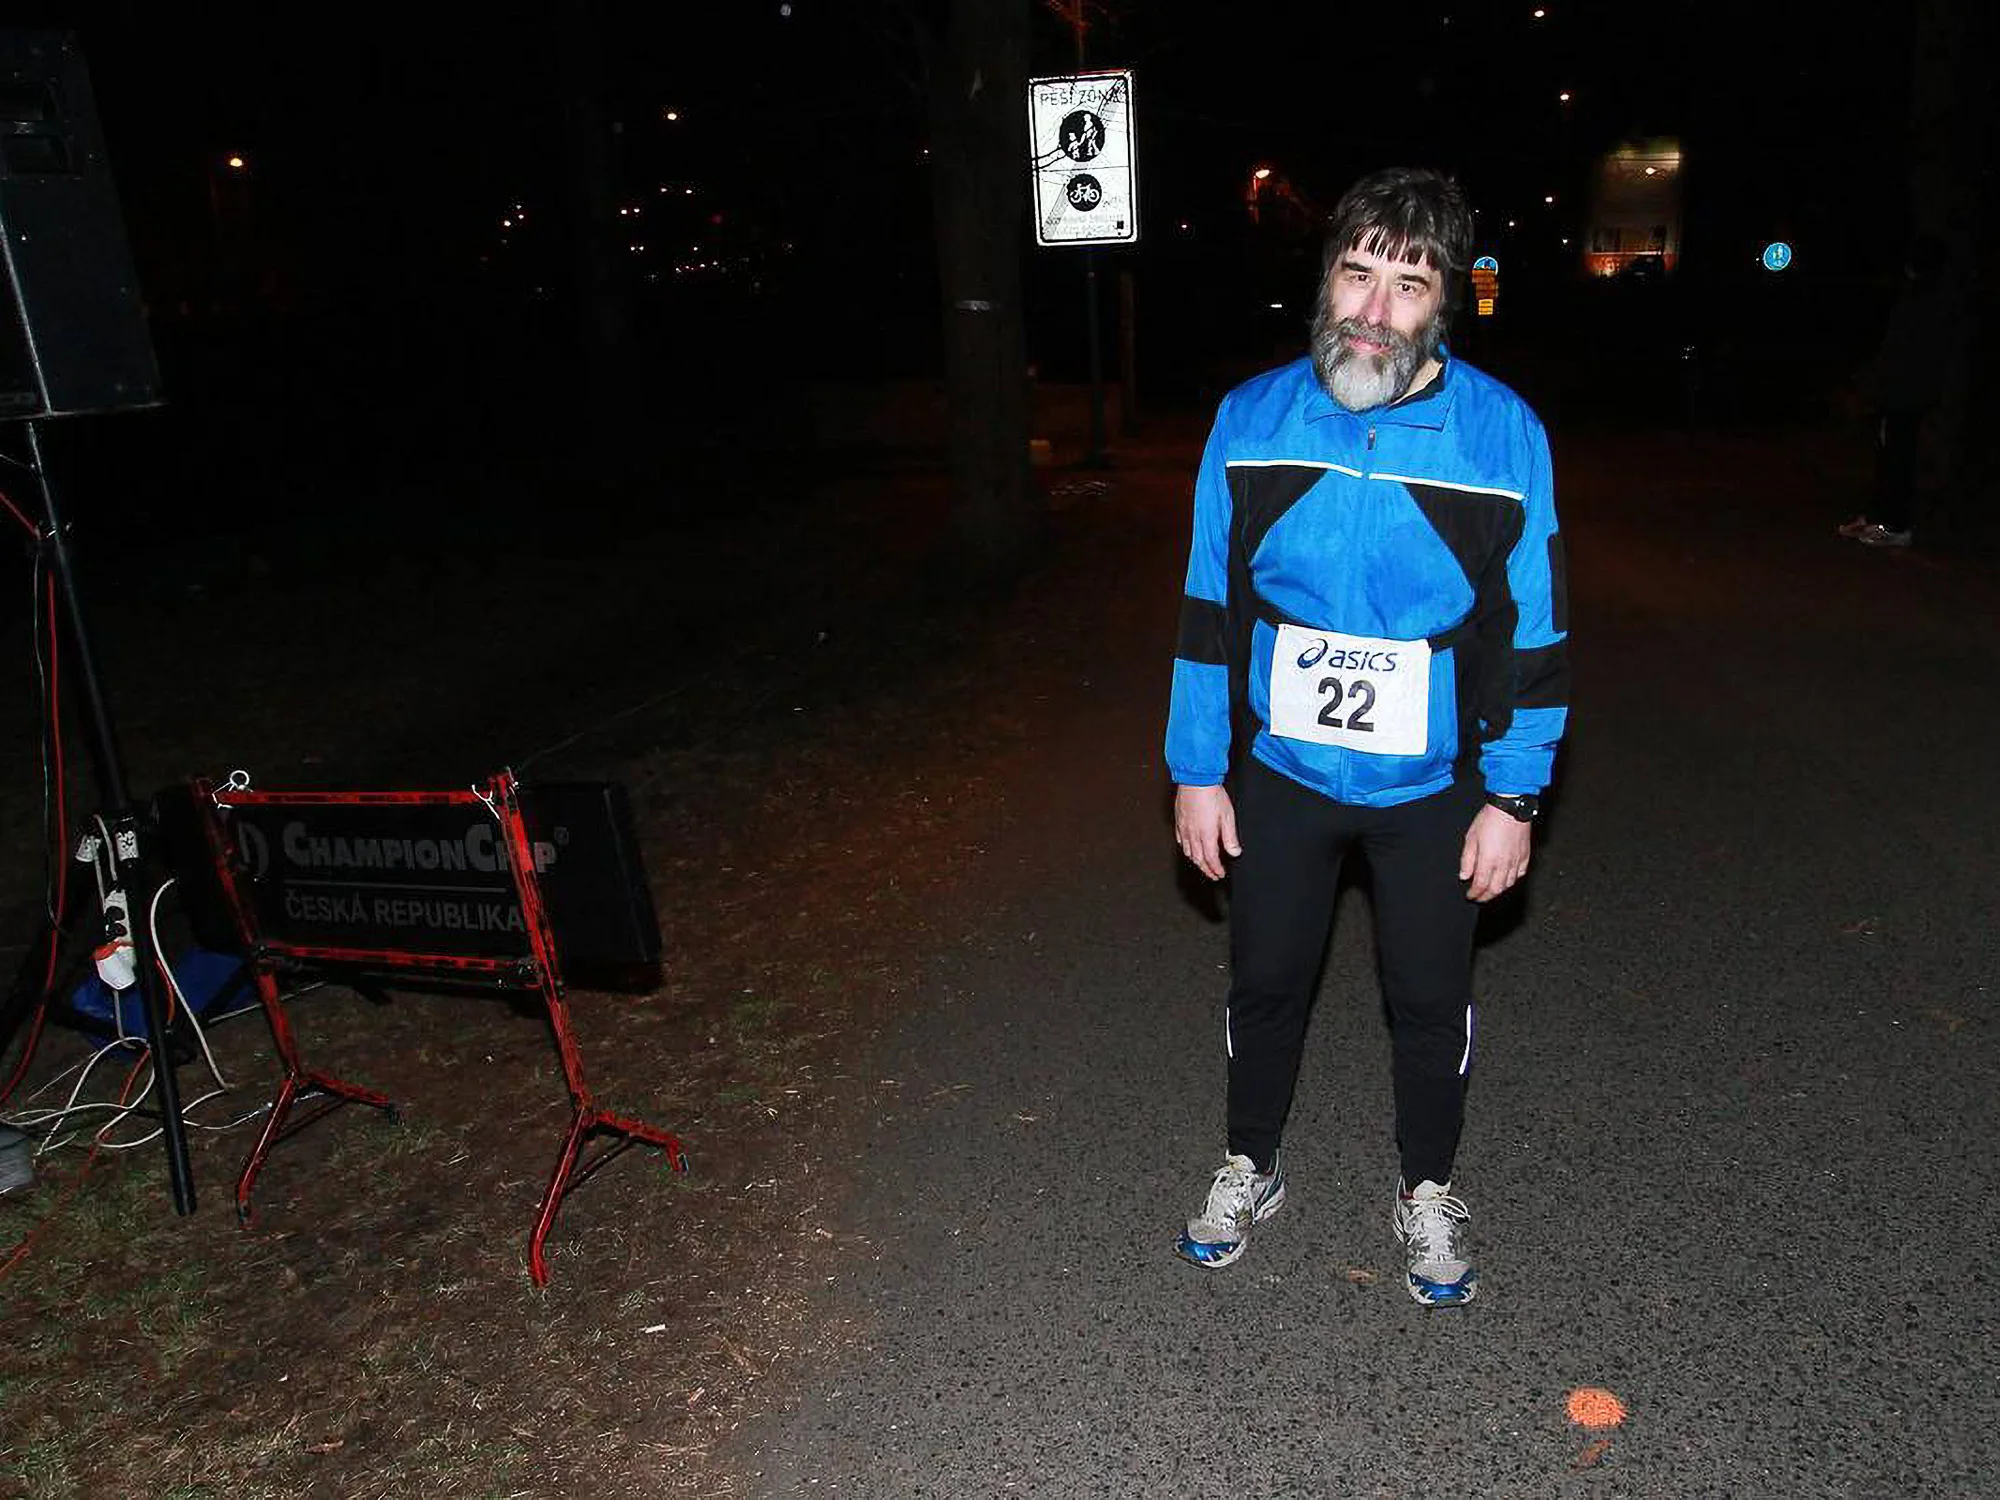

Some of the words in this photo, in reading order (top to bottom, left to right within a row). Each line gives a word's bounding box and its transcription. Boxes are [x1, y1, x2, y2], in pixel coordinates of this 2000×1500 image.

[1328, 648, 1398, 672] asics
[1317, 676, 1376, 732] 22
[284, 888, 369, 925] ČESKÁ
[373, 898, 526, 933] REPUBLIKA
